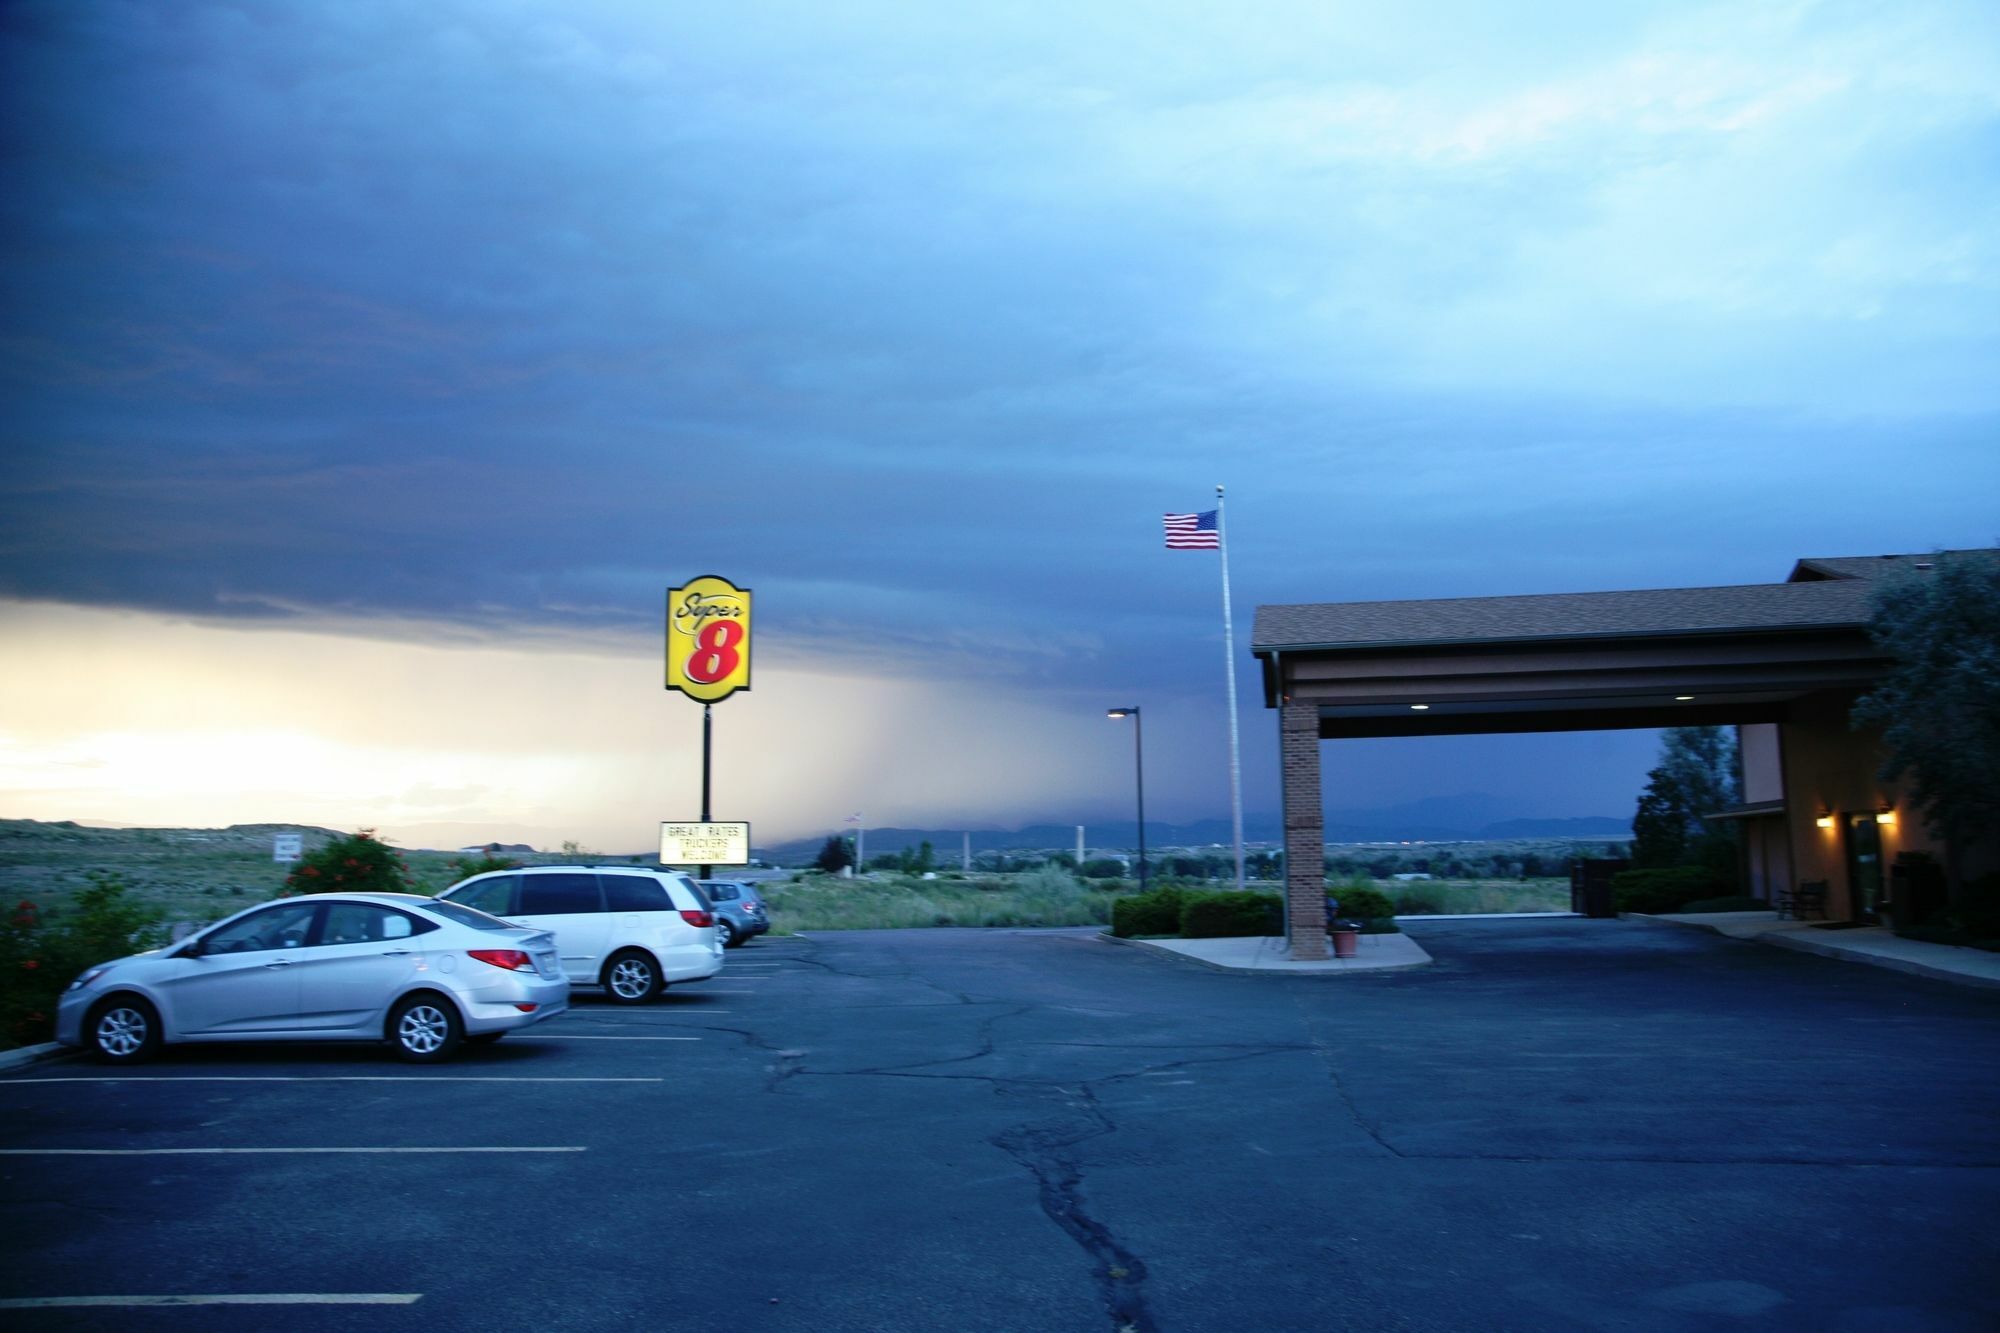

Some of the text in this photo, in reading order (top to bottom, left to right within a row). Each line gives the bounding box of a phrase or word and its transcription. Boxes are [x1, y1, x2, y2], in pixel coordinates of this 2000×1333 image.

[676, 592, 744, 630] Super
[682, 619, 744, 684] 8
[669, 826, 739, 836] GREAT RATES
[679, 839, 728, 848] TRUCKERS
[682, 850, 727, 860] WELCOME
